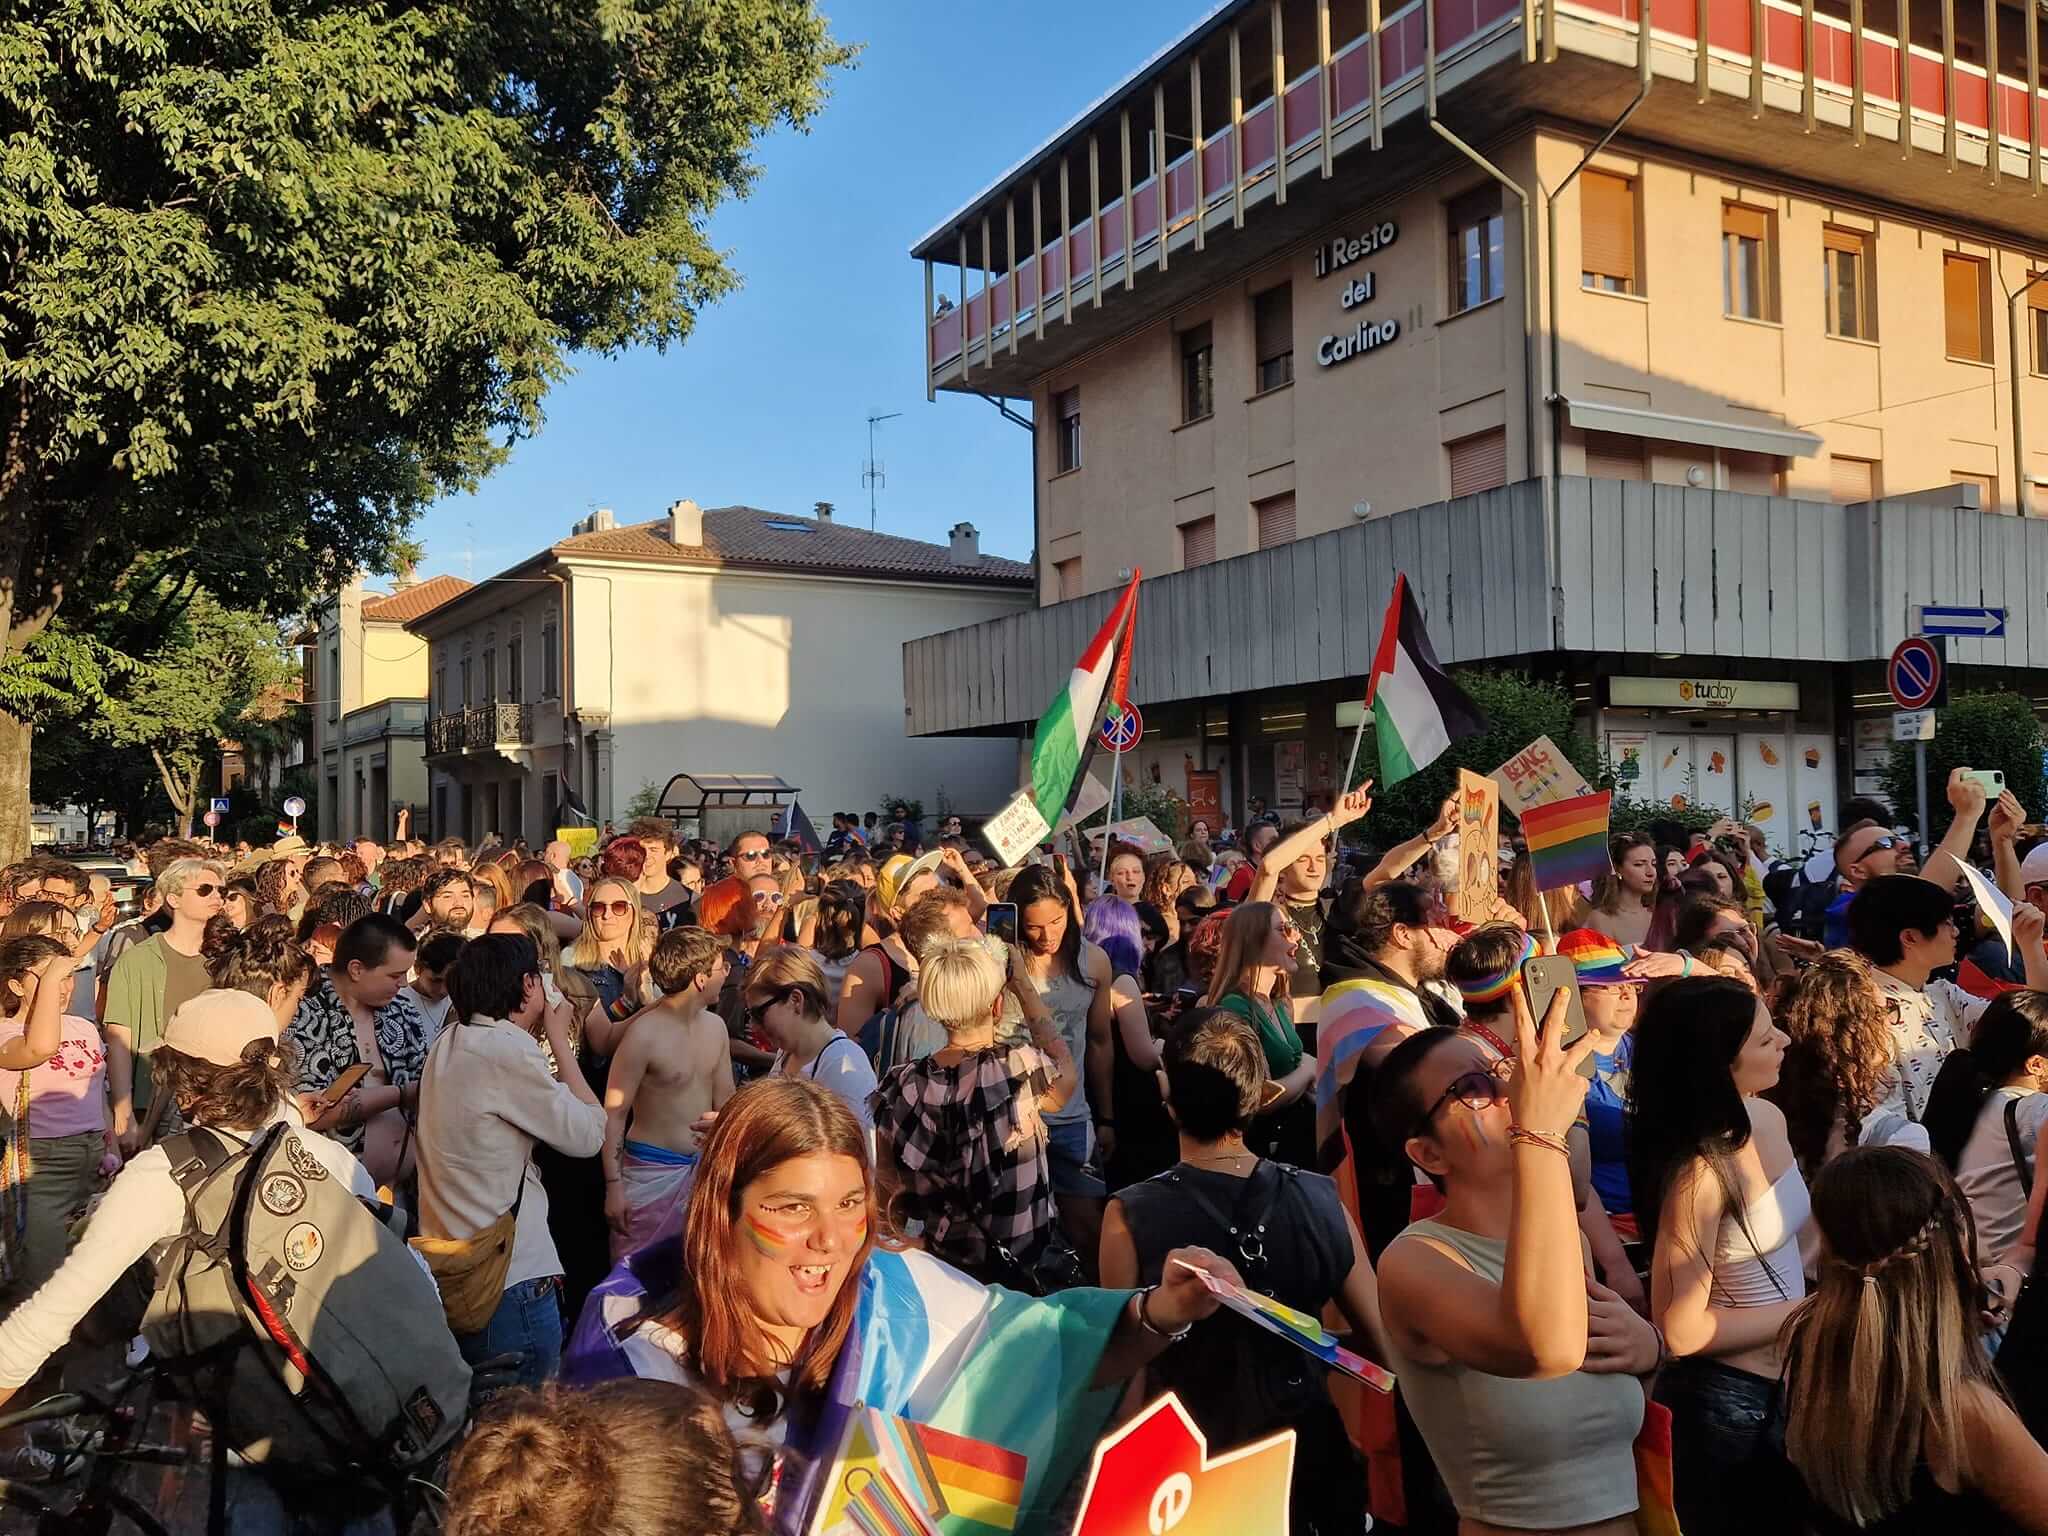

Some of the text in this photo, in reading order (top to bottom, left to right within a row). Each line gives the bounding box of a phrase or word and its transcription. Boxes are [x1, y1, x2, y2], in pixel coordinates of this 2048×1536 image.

[1315, 221, 1396, 277] il Resto
[1341, 272, 1374, 309] del
[1316, 319, 1397, 366] Carlino
[1694, 681, 1737, 704] tuday
[1503, 744, 1549, 782] BEING
